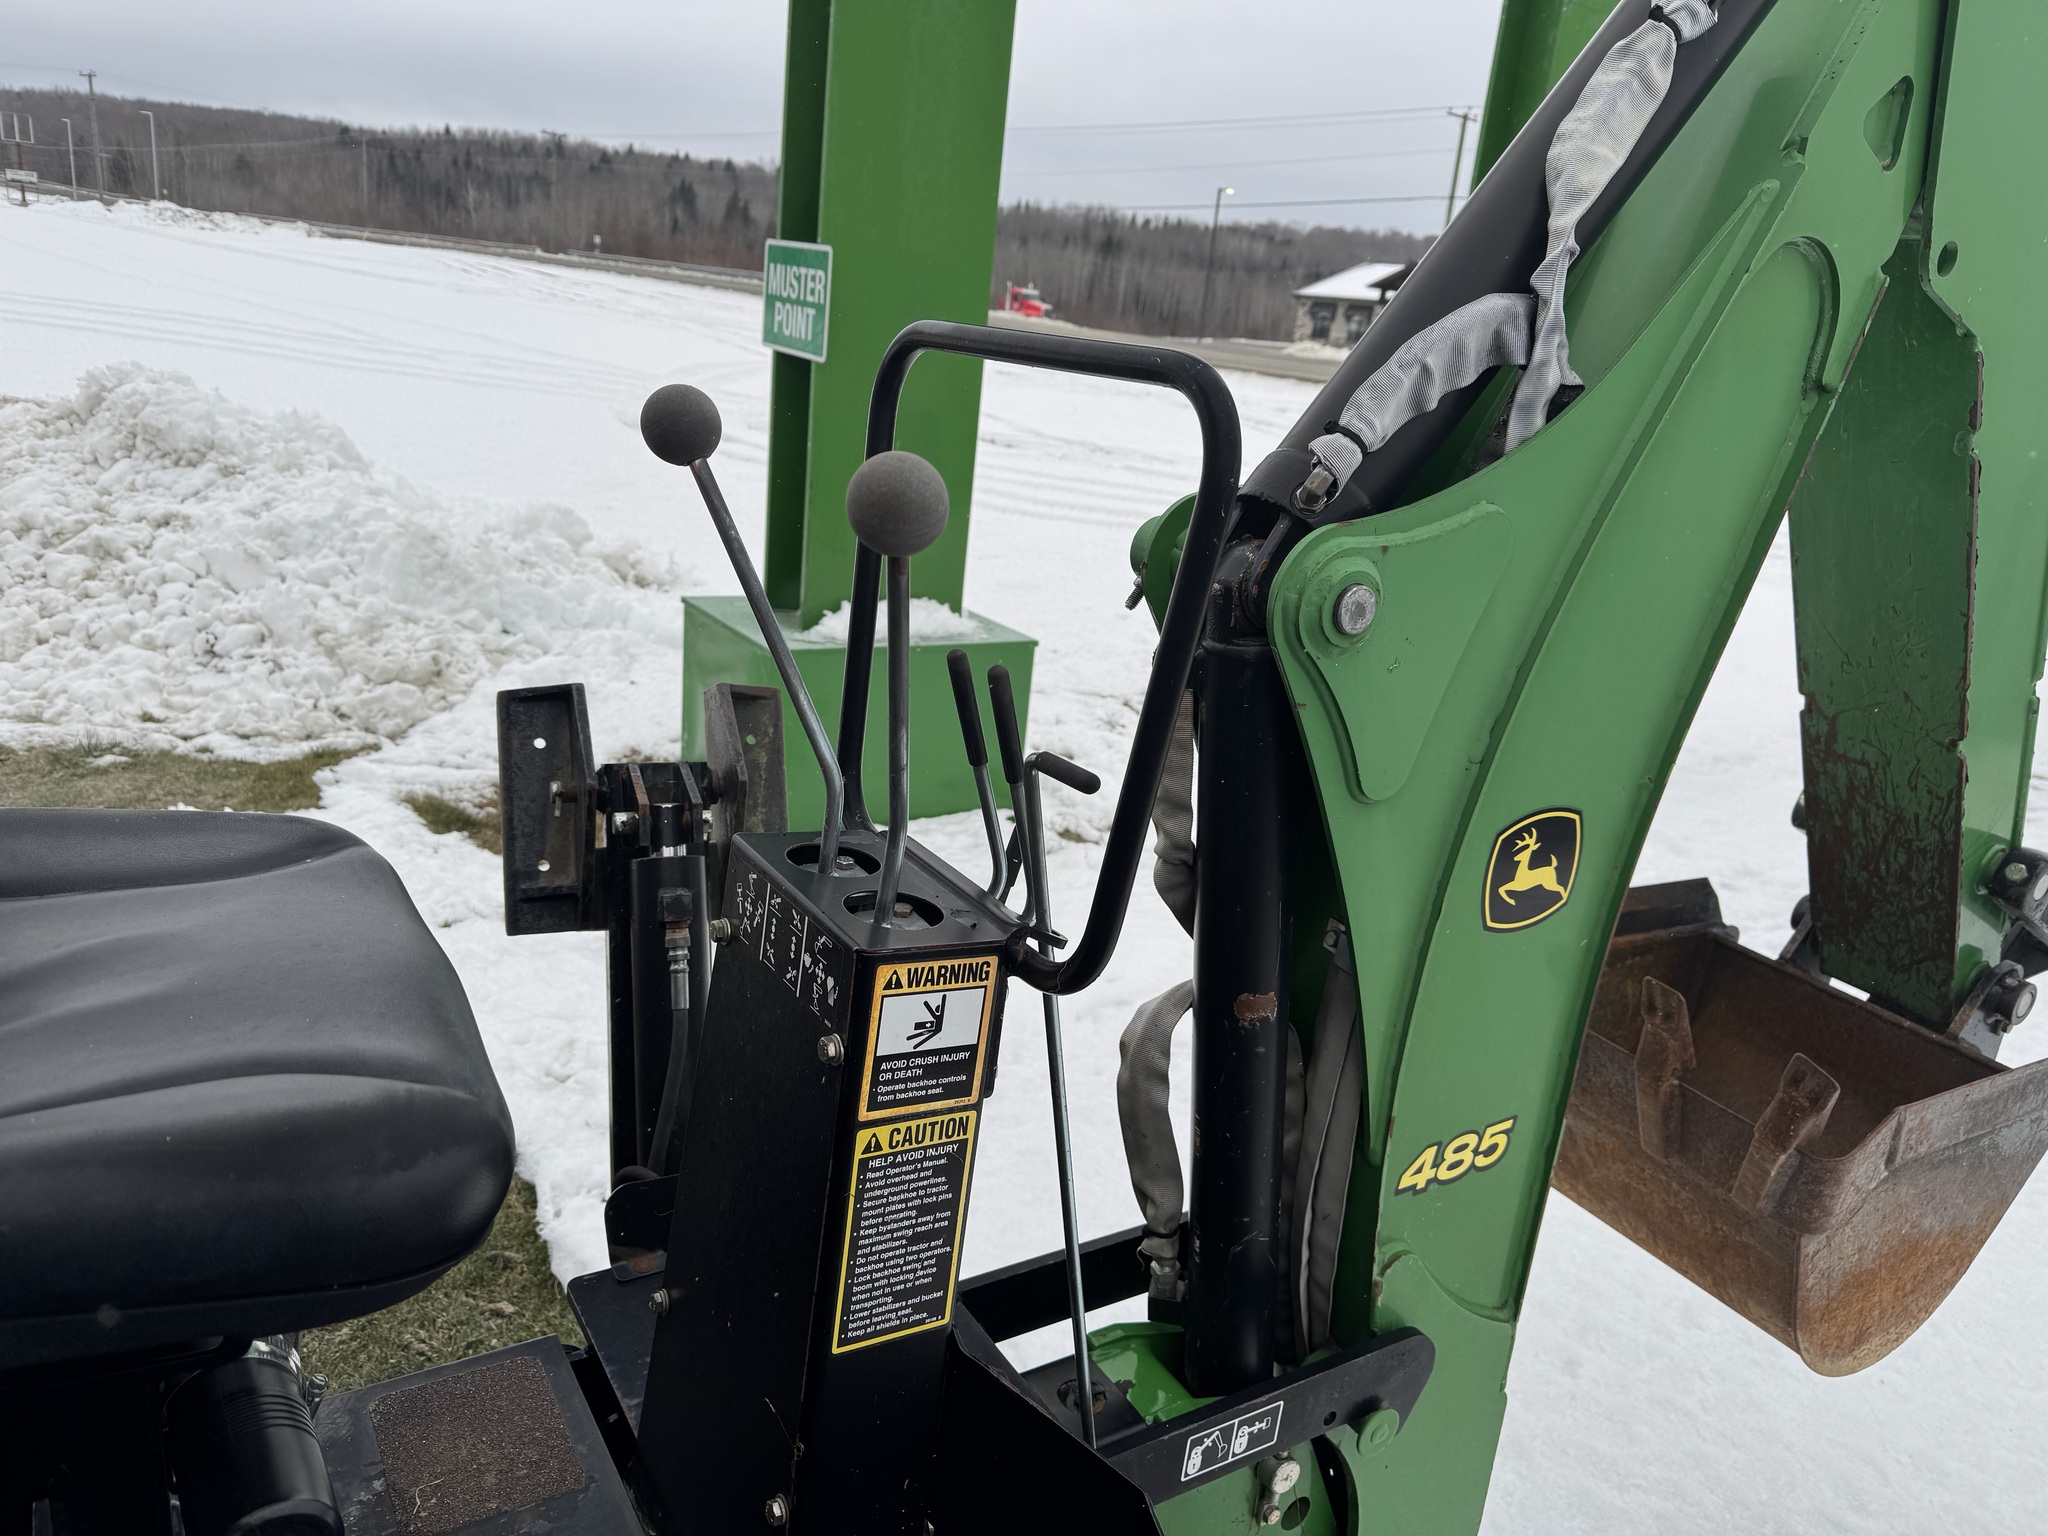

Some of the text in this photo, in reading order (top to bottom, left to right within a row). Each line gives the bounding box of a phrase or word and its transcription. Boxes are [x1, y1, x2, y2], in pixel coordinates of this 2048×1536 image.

[768, 262, 826, 305] MUSTER
[774, 301, 816, 341] POINT
[907, 961, 991, 988] WARNING
[881, 1052, 970, 1070] AVOID CRUSH INJURY
[877, 1074, 966, 1093] Operate backhoe controls
[879, 1068, 923, 1081] OR DEATH
[877, 1087, 944, 1102] from backhoe seat.
[888, 1115, 970, 1149] CAUTION
[869, 1144, 959, 1168] HELP AVOID INJURY
[1394, 1115, 1517, 1196] 485
[865, 1180, 885, 1189] Avoid
[887, 1172, 918, 1184] overhead
[866, 1158, 948, 1179] Read Operator's Manual.
[863, 1198, 887, 1208] Secure
[889, 1191, 917, 1202] backhoe
[927, 1185, 949, 1194] tractor
[864, 1177, 947, 1198] underground powerlines.
[862, 1208, 883, 1217] mount
[886, 1203, 905, 1212] plates
[938, 1193, 952, 1202] pins
[860, 1211, 951, 1236] Keep bystanders away from
[861, 1211, 917, 1226] before operating.
[858, 1233, 891, 1246] maximum
[893, 1229, 913, 1238] swing
[914, 1224, 933, 1232] reach
[857, 1240, 908, 1255] and stabilizers.
[868, 1254, 878, 1262] not
[880, 1248, 906, 1259] operate
[908, 1242, 928, 1252] tractor
[931, 1238, 943, 1246] and
[854, 1258, 936, 1283] Lock backhoe swing and
[855, 1263, 884, 1274] backhoe
[886, 1258, 904, 1266] using
[920, 1247, 952, 1259] operators.
[852, 1292, 870, 1301] when
[915, 1277, 932, 1285] when
[853, 1267, 936, 1292] boom with locking device
[850, 1290, 944, 1320] Lower stabilizers and bucket
[851, 1296, 894, 1311] transporting.
[848, 1308, 913, 1328] before leaving seat.
[848, 1328, 864, 1338] Keep
[876, 1317, 900, 1330] shields
[910, 1312, 928, 1322] place.
